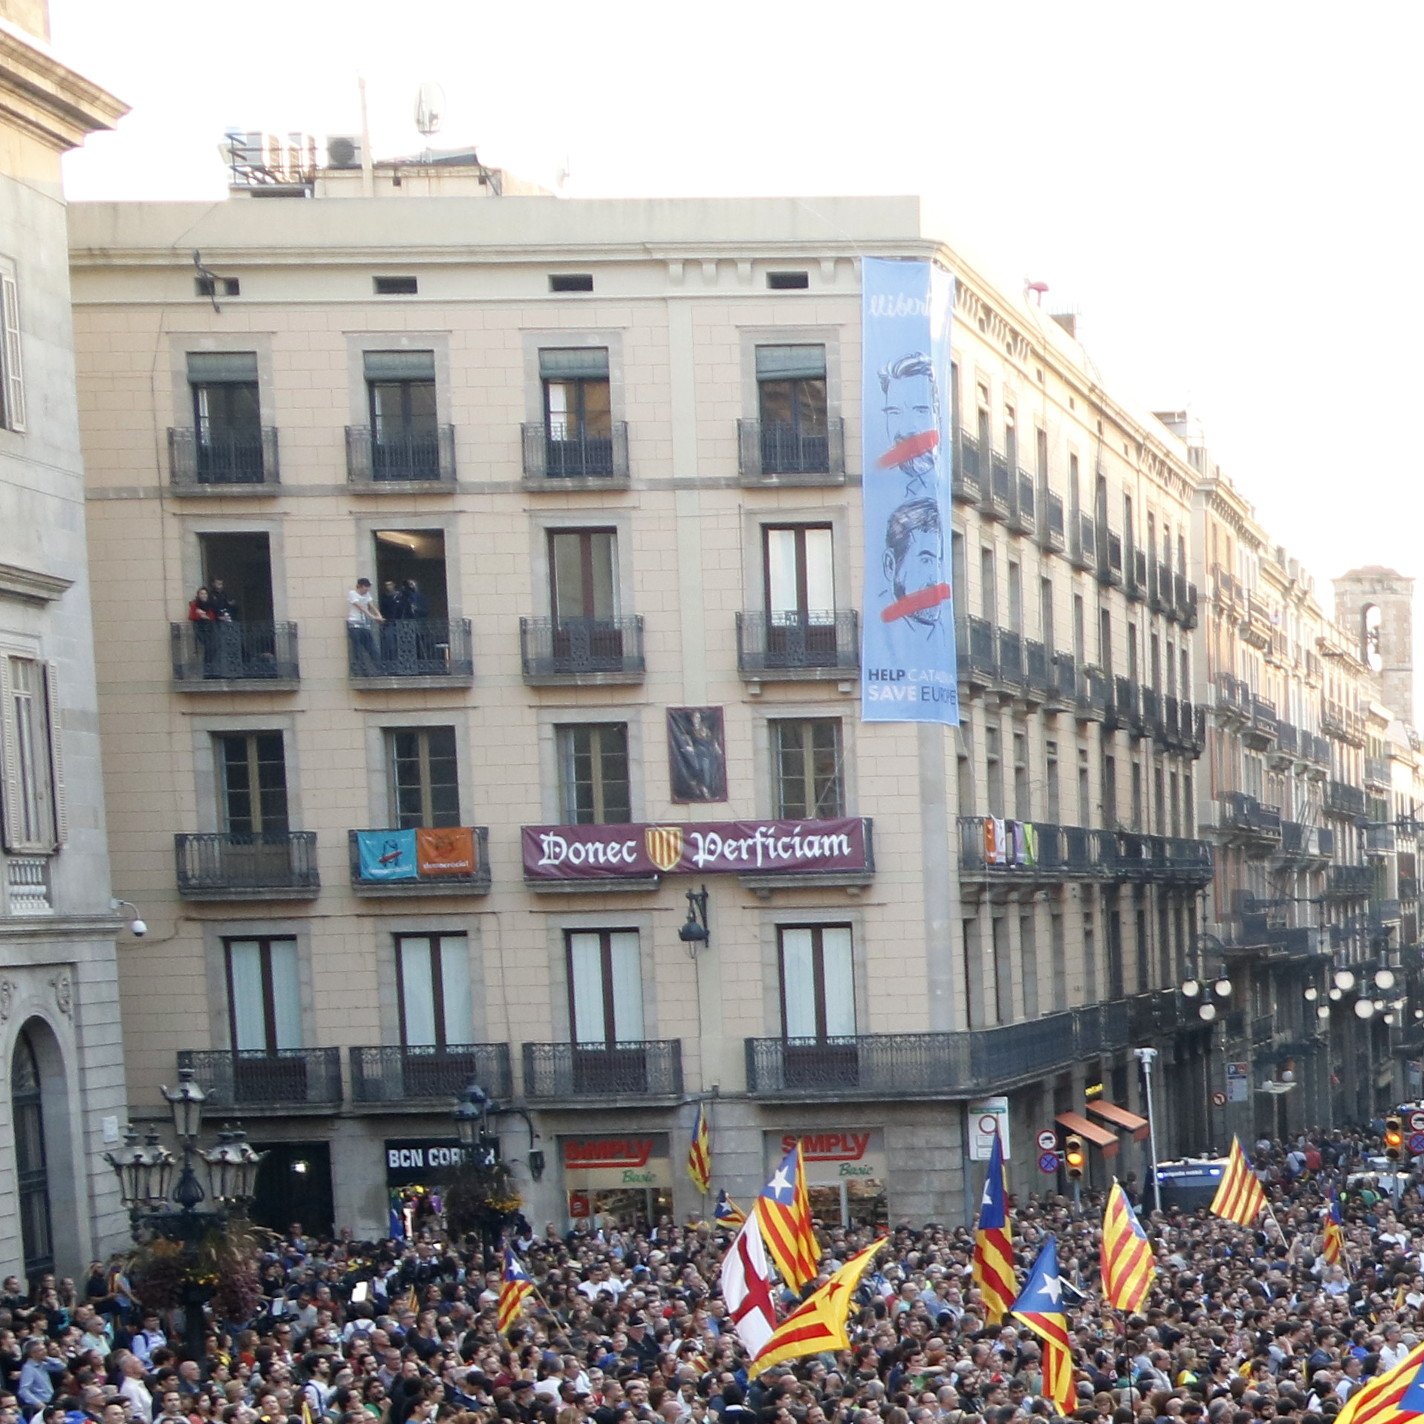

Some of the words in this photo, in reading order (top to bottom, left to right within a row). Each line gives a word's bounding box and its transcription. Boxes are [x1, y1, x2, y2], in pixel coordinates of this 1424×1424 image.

[868, 668, 905, 681] HELP
[868, 684, 917, 701] SAVE
[538, 825, 638, 867] Donec
[691, 825, 852, 868] Perficiam
[781, 1132, 869, 1160] SMPLY
[389, 1149, 423, 1168] BCN
[839, 1162, 873, 1176] Basic
